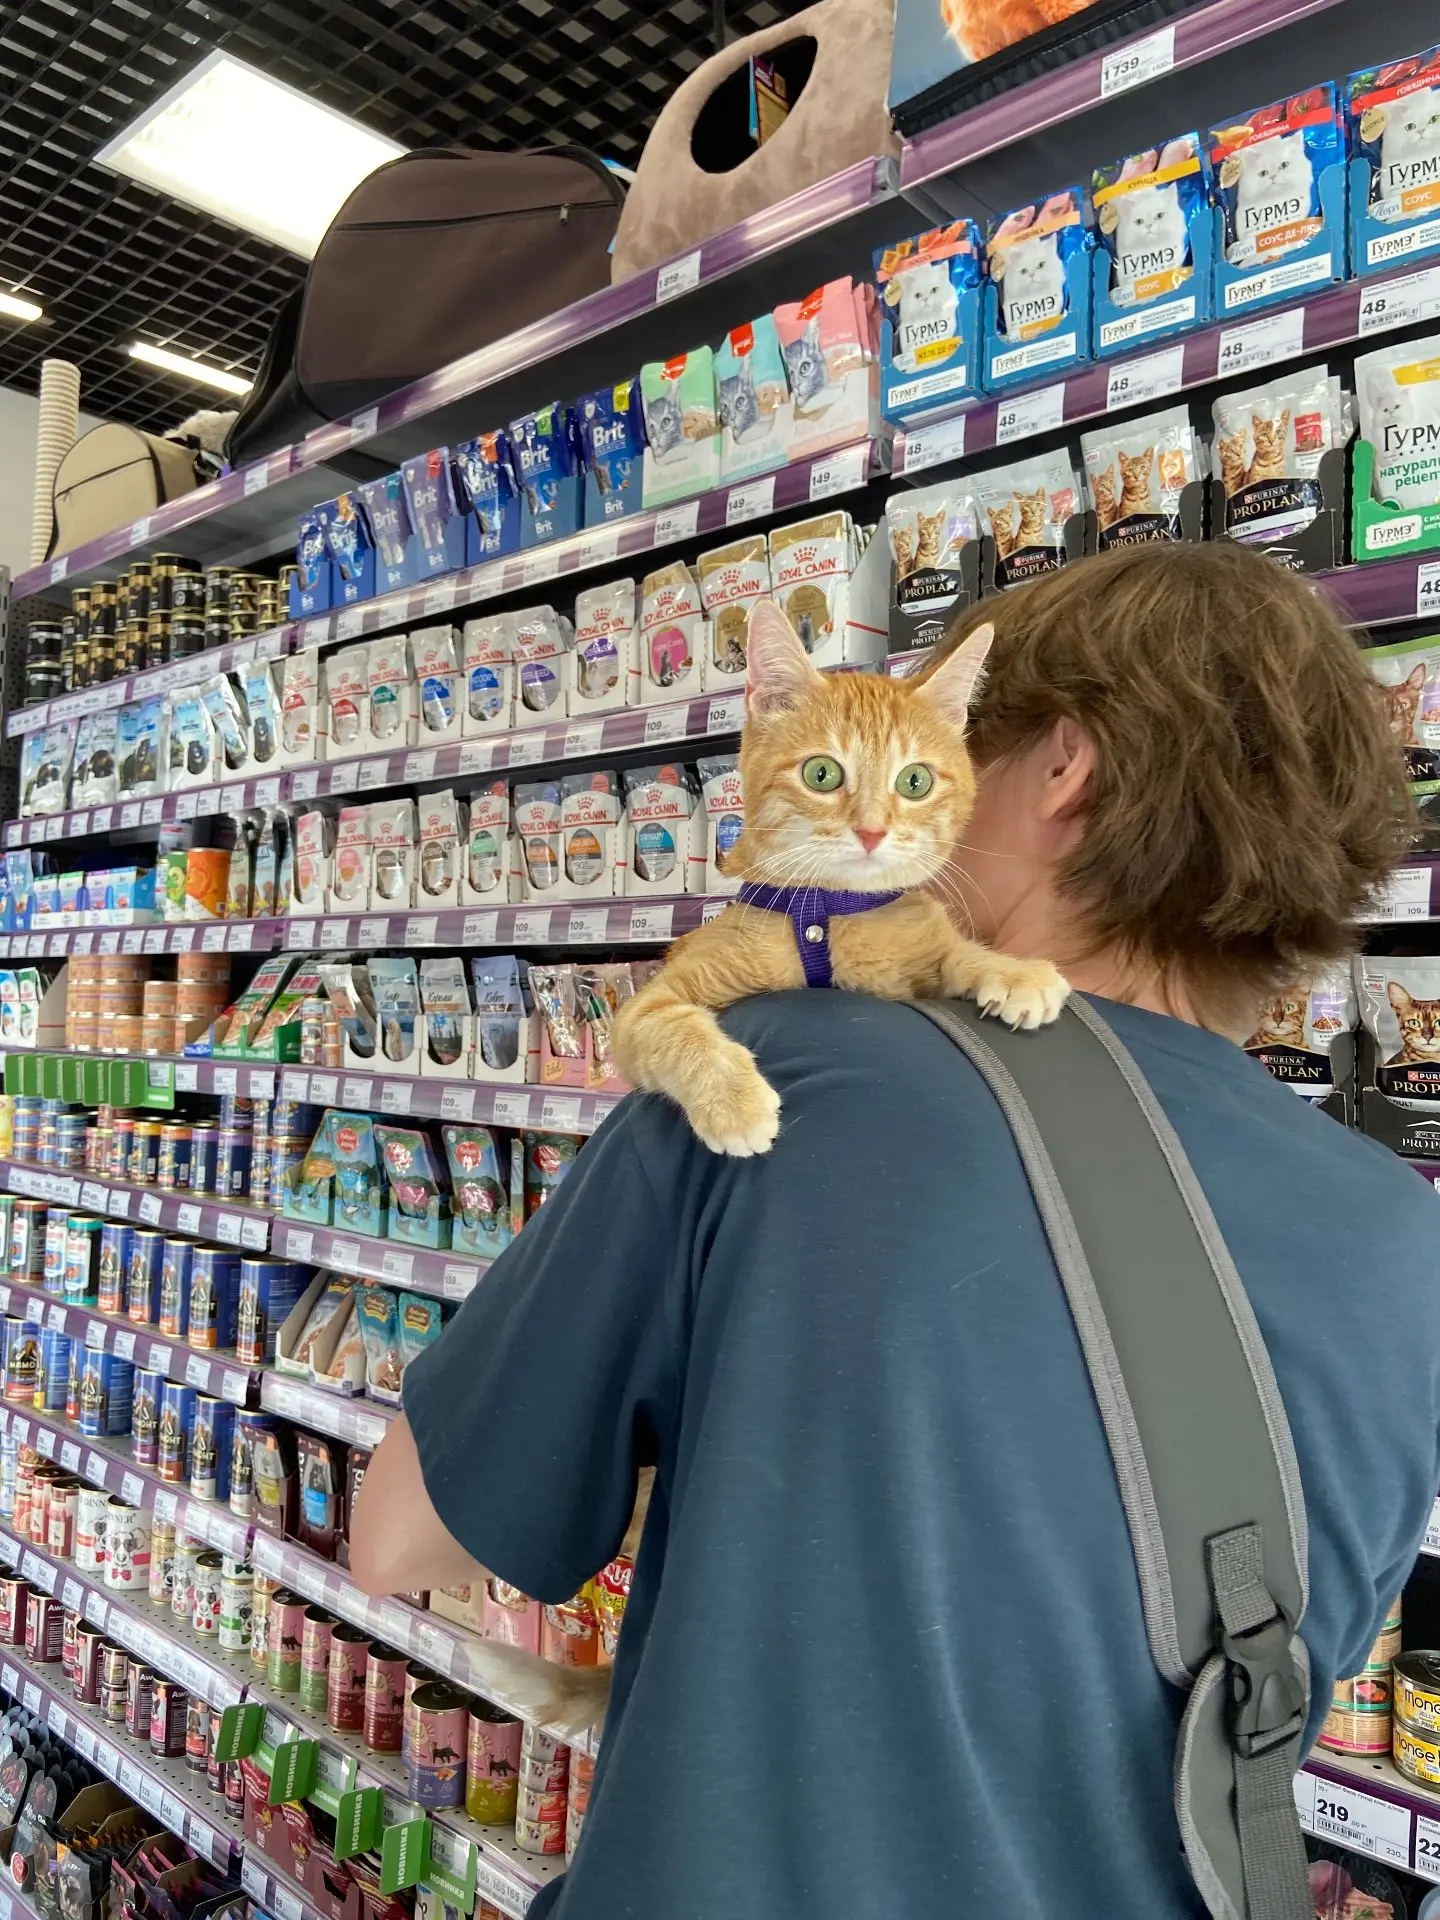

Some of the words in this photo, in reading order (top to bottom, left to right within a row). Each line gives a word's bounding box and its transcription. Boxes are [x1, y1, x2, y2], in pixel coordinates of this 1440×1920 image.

[1404, 190, 1433, 206] СОУС
[1244, 198, 1301, 229] ГУРМЭ
[1258, 234, 1282, 248] СОУС
[1372, 235, 1412, 260] ГУРМЭ
[1122, 247, 1175, 275] ГУРМЭ
[1009, 296, 1055, 322] ГУРМЭ
[1362, 299, 1386, 315] 48
[905, 319, 949, 344] ГУРМЭ
[1221, 342, 1243, 358] 48
[1110, 377, 1129, 393] 48
[999, 413, 1016, 428] 48
[593, 421, 625, 448] Brit
[906, 442, 922, 456] 48
[812, 471, 830, 486] 149
[414, 486, 438, 508] Brit
[729, 498, 745, 511] 149
[604, 498, 625, 514] Brit
[1233, 500, 1262, 520] PRO
[373, 508, 399, 530] Brit
[657, 520, 672, 532] 149
[534, 520, 553, 535] Brit
[804, 557, 836, 575] CANIN
[1006, 565, 1029, 581] PRO
[730, 578, 760, 596] CANIN
[904, 586, 925, 599] PRO
[709, 709, 726, 721] 109
[647, 720, 662, 732] 109
[653, 803, 679, 815] CANIN
[1408, 907, 1422, 915] 109
[515, 923, 529, 933] 109
[570, 921, 584, 931] 109
[631, 919, 647, 929] 109
[1279, 1065, 1320, 1078] PLAN
[1393, 1080, 1428, 1095] PRO
[543, 1106, 554, 1117] 89
[1316, 1798, 1349, 1822] 219
[1385, 1847, 1402, 1859] 230
[429, 1871, 465, 1900] новинка
